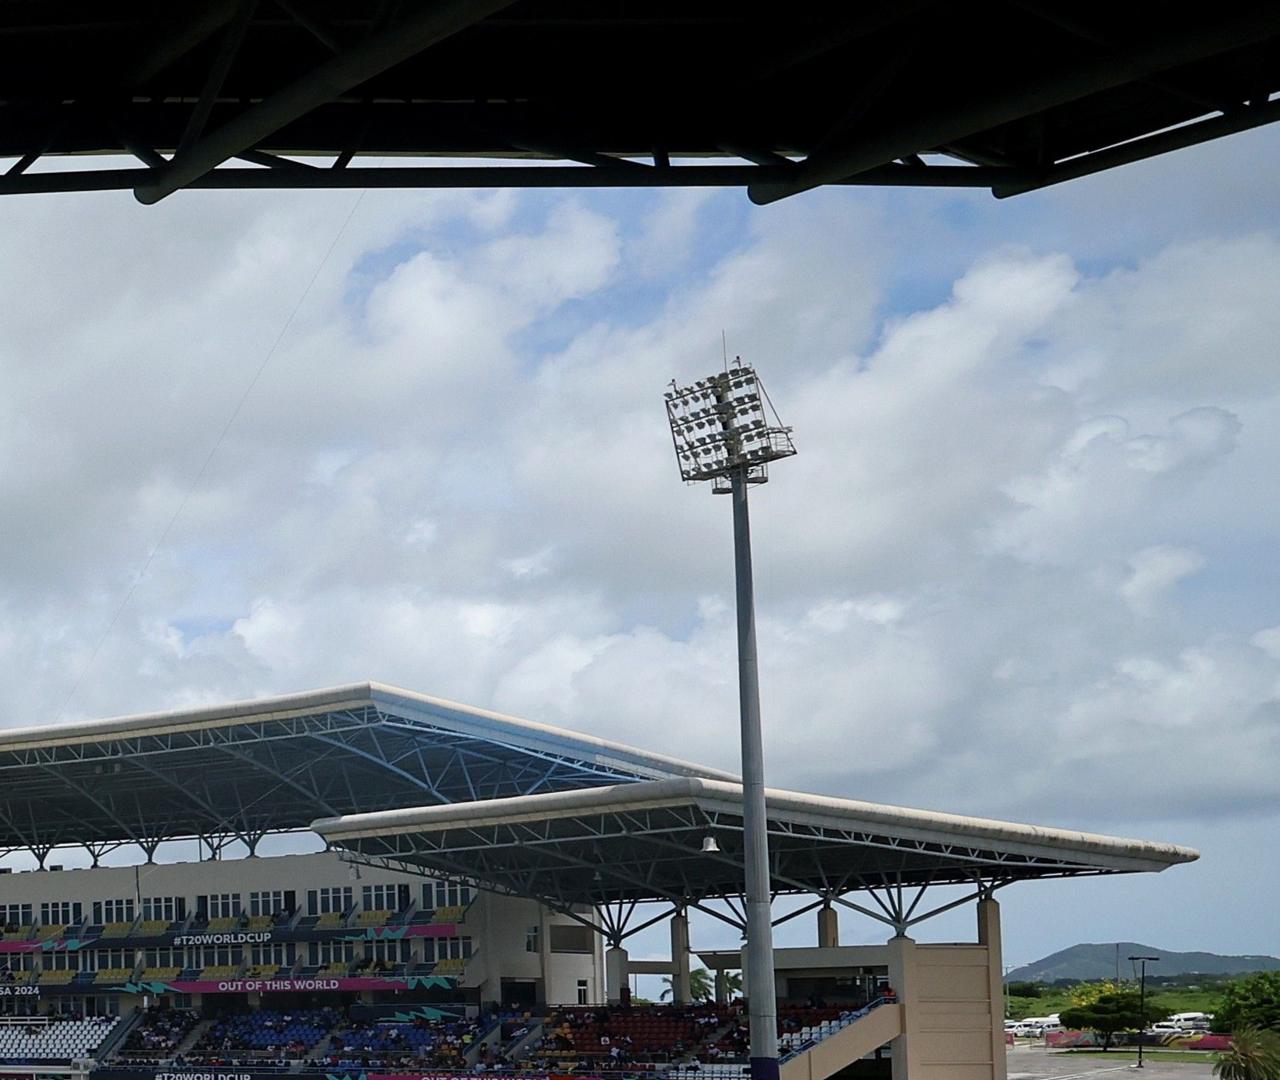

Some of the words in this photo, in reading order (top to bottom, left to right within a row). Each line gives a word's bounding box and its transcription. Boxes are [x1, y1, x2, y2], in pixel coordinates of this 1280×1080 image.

[174, 933, 272, 946] #T20WORLDCUP
[14, 986, 40, 996] 2024
[218, 982, 243, 991] OUT
[246, 982, 262, 990] OF
[265, 981, 291, 990] THIS
[293, 980, 339, 990] WORLD
